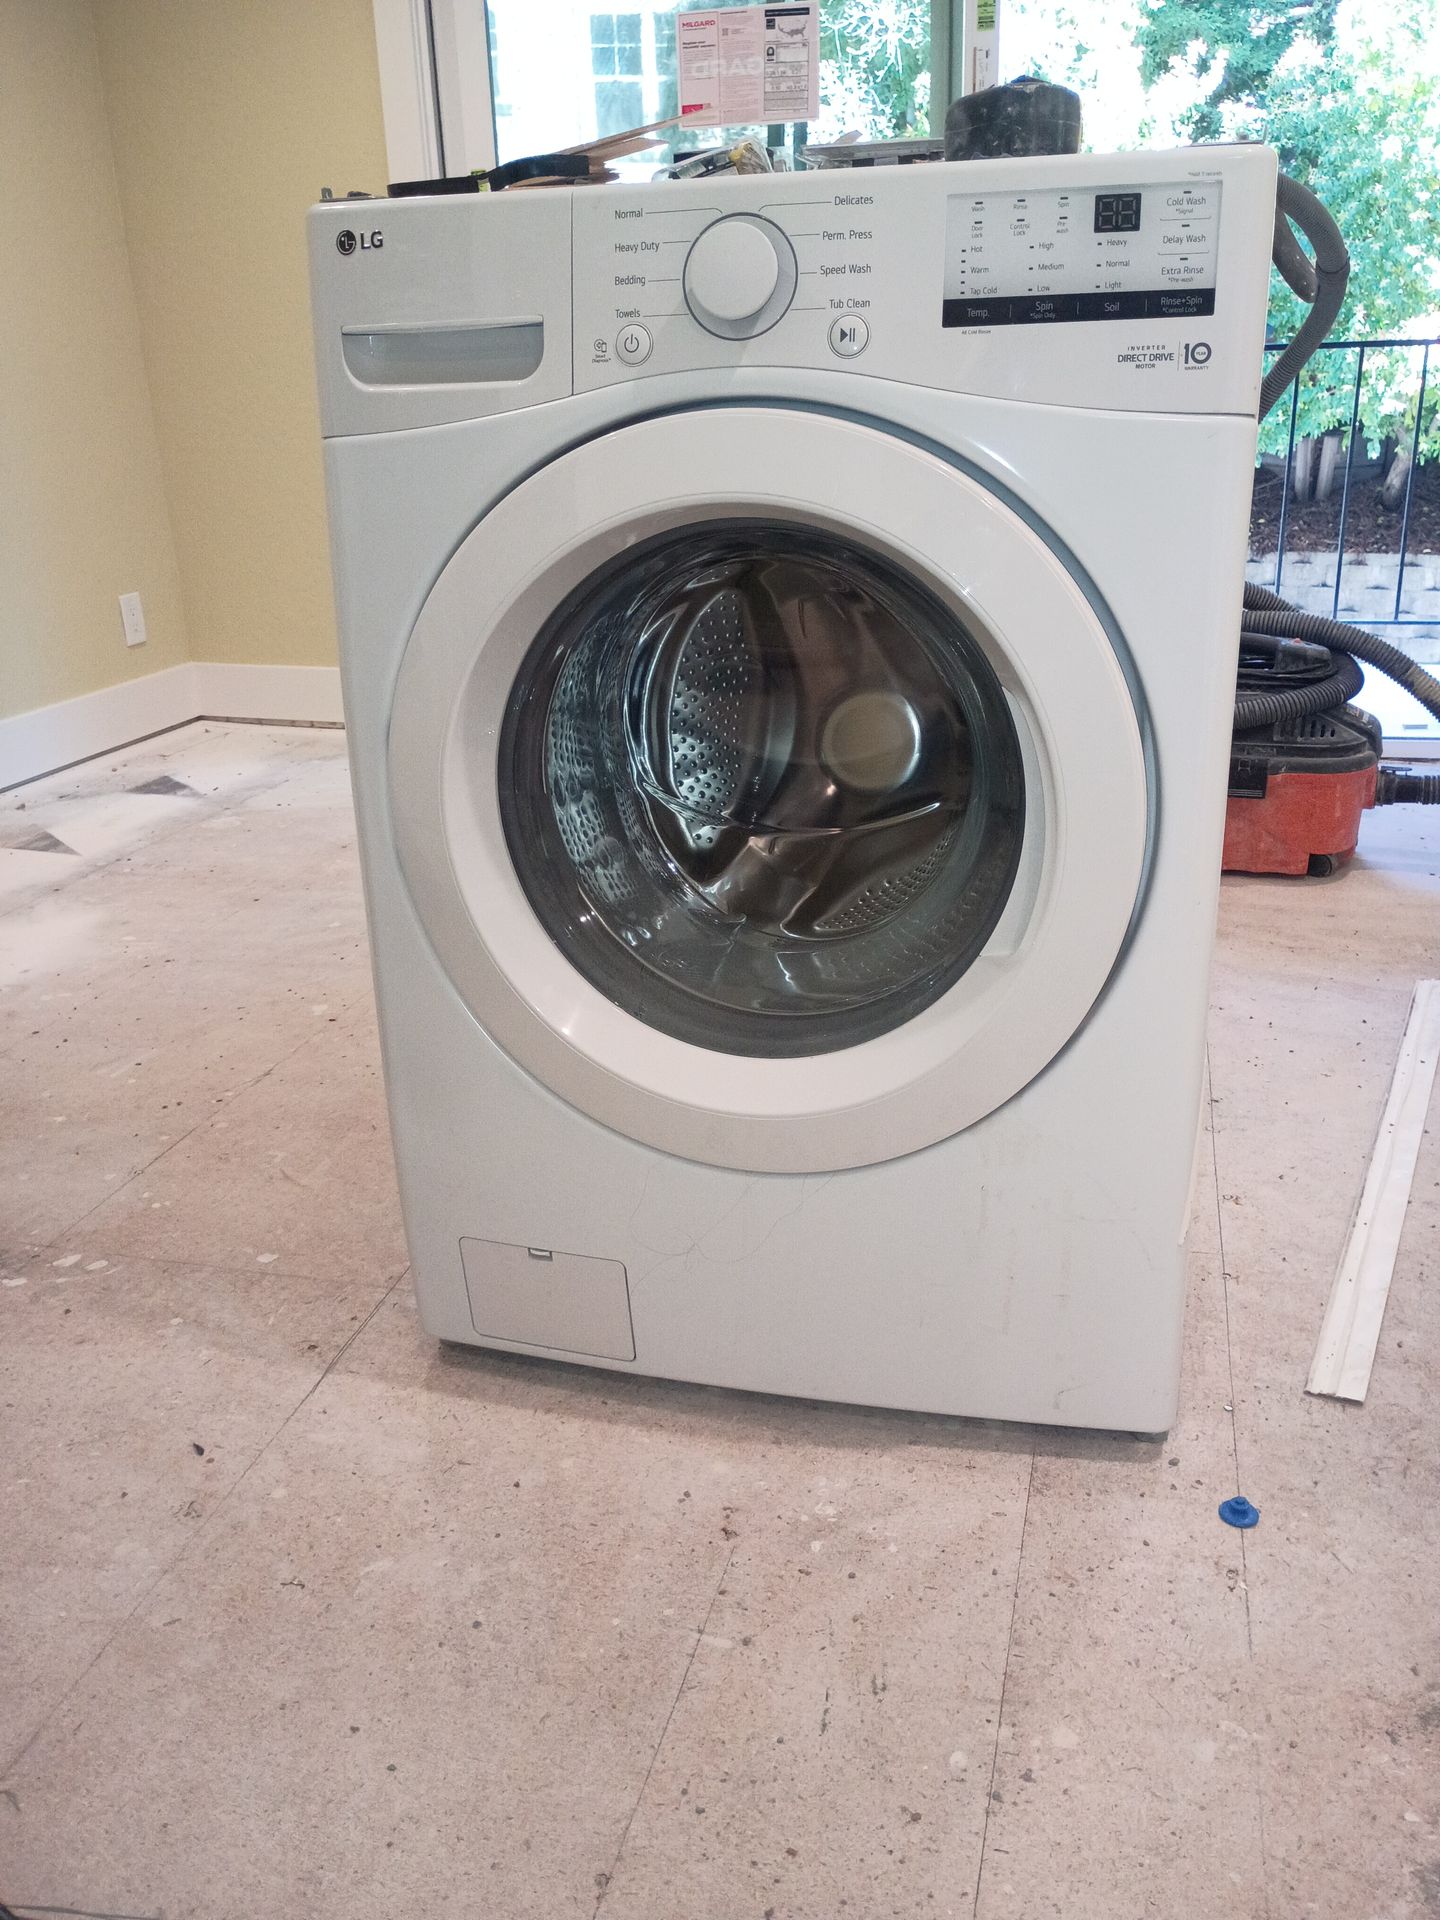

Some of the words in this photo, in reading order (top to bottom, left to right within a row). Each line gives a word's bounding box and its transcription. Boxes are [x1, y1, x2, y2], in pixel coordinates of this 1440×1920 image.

[682, 20, 716, 28] MILGARD
[834, 195, 874, 206] Delicates
[1166, 197, 1184, 207] Cold
[1186, 196, 1206, 206] Wash
[614, 208, 643, 220] Normal
[360, 231, 384, 250] LG
[822, 230, 847, 241] Perm.
[849, 229, 873, 240] Press
[1162, 235, 1184, 246] Delay
[1186, 234, 1206, 243] Wash
[614, 243, 639, 254] Heavy
[641, 241, 660, 252] Duty
[1038, 242, 1054, 251] High
[1106, 239, 1128, 247] Heavy
[970, 245, 983, 253] Hot
[1037, 263, 1065, 271] Medium
[1105, 259, 1130, 268] Normal
[820, 264, 847, 277] Speed
[848, 264, 872, 274] Wash
[970, 266, 989, 274] Warm
[1161, 266, 1182, 276] Extra
[1183, 265, 1204, 275] Rinse
[614, 275, 646, 287] Bedding
[1104, 281, 1122, 290] Light
[970, 287, 981, 296] Tap
[982, 286, 998, 295] Cold
[1037, 285, 1050, 293] Low
[829, 299, 844, 309] Tub
[846, 298, 871, 308] Clean
[1035, 301, 1054, 312] Spin
[1104, 302, 1120, 312] Soil
[615, 308, 641, 319] Towels
[967, 308, 990, 319] Temp.
[1117, 353, 1147, 363] DIRECT
[1149, 352, 1175, 362] DRIVE
[1184, 342, 1212, 365] 10
